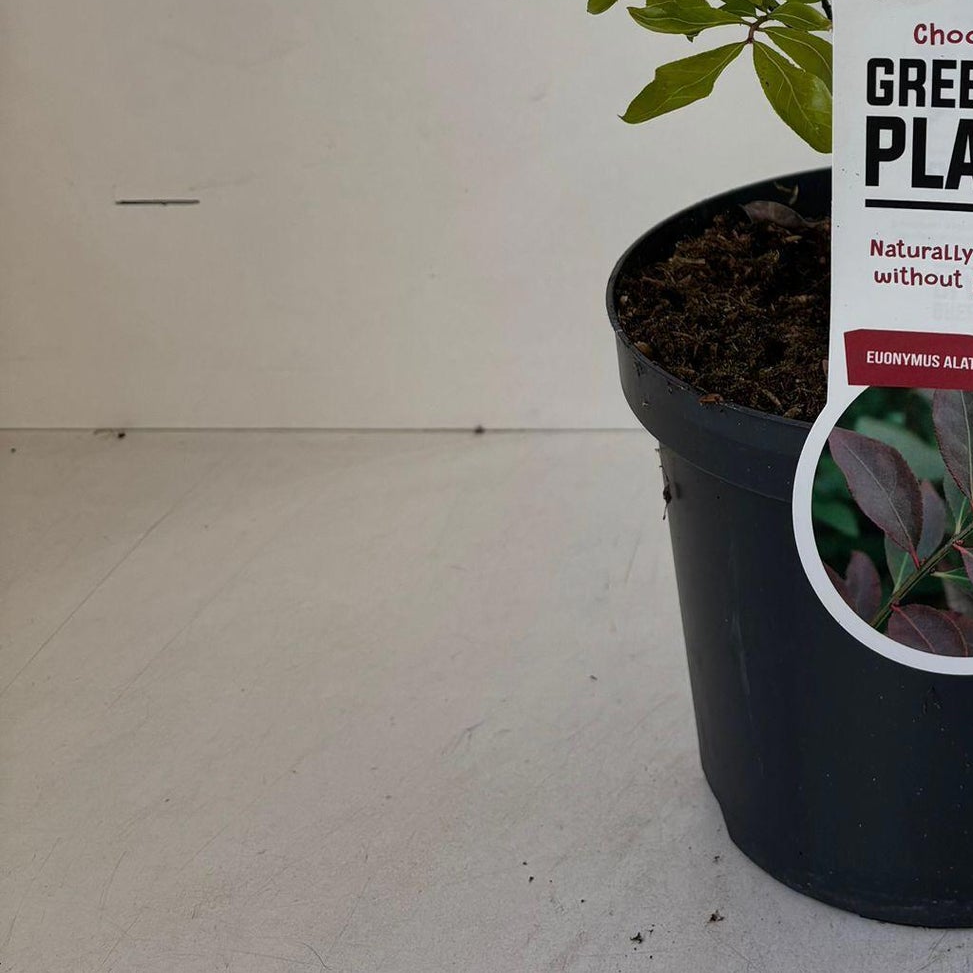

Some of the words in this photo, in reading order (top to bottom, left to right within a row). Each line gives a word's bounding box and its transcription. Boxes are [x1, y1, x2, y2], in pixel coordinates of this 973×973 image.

[870, 239, 973, 265] Naturally
[873, 266, 963, 289] without
[866, 350, 940, 368] EUONYMUS
